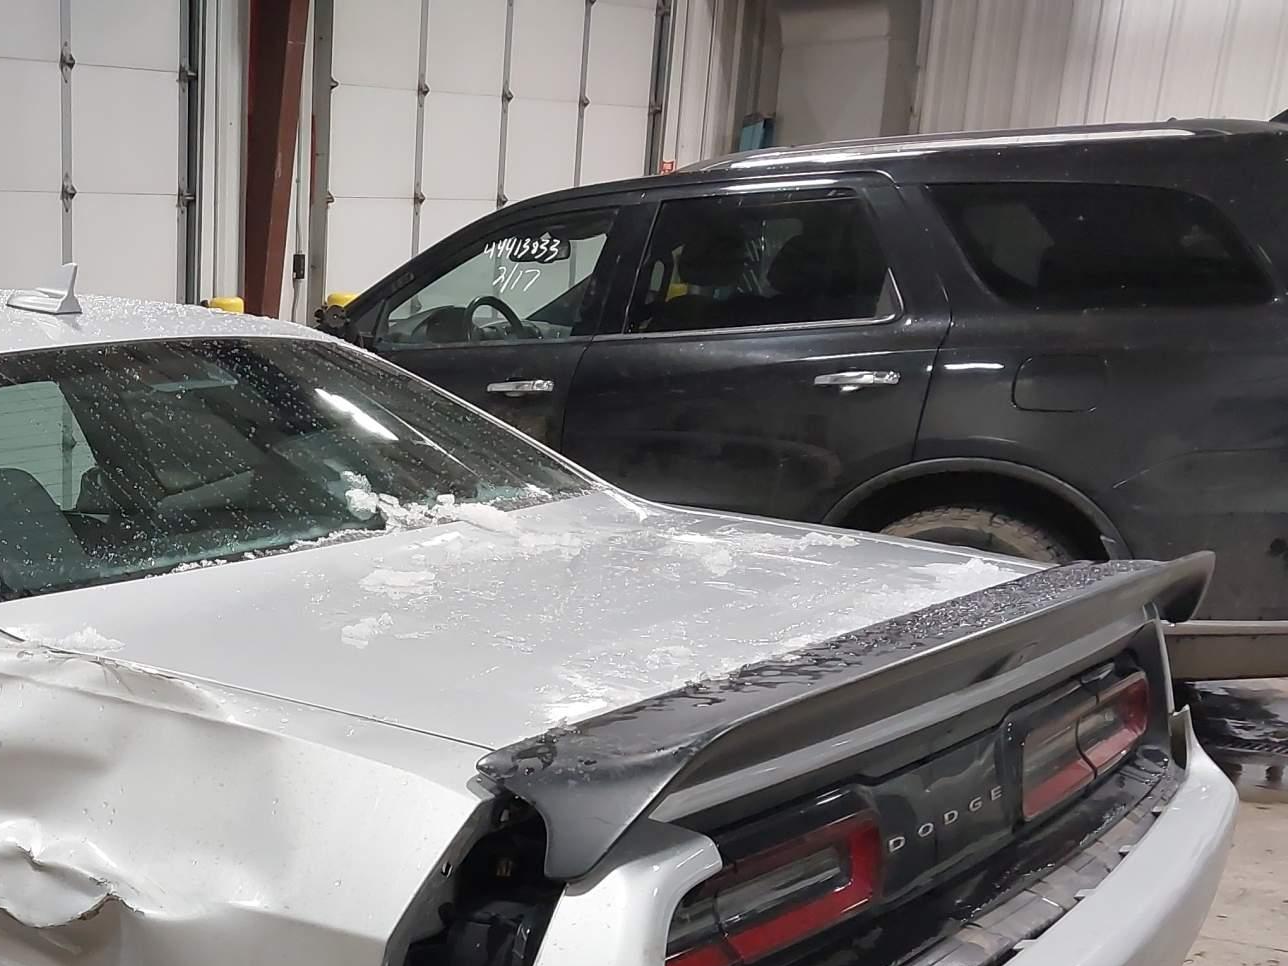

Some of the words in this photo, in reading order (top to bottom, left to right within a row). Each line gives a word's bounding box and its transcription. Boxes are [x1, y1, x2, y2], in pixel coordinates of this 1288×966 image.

[484, 236, 561, 262] 44413833
[492, 263, 541, 293] 2/17
[888, 785, 1003, 852] DODGE
